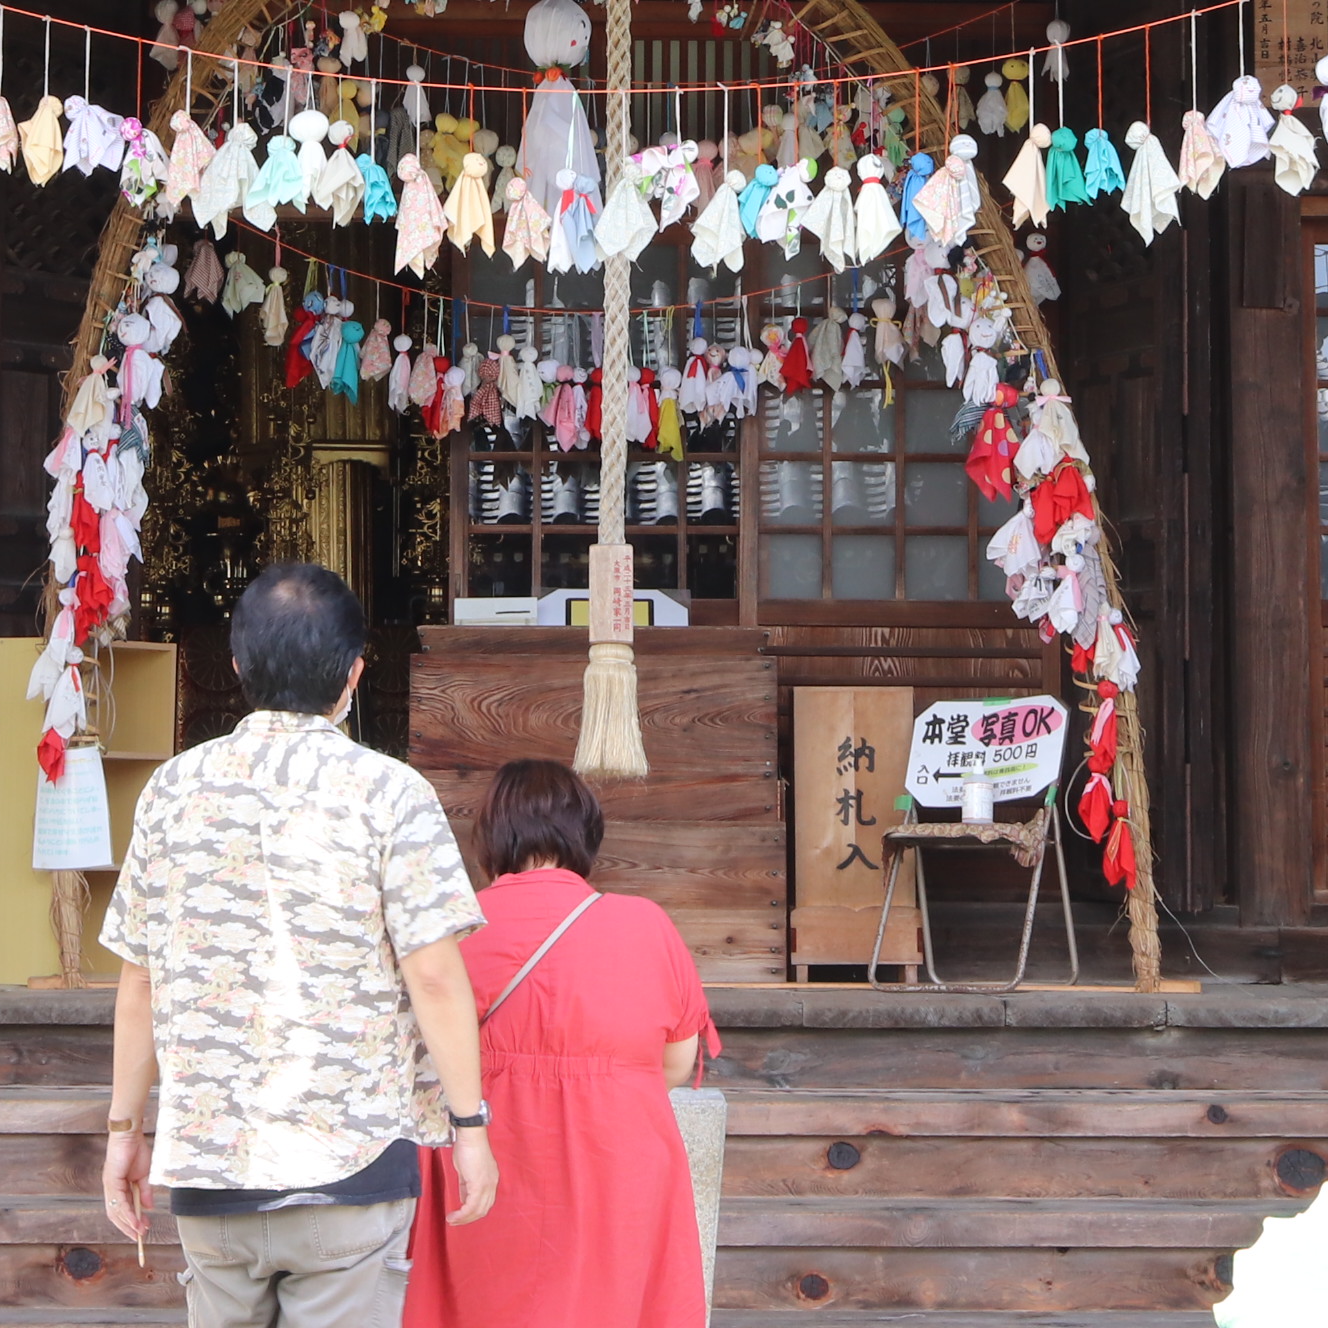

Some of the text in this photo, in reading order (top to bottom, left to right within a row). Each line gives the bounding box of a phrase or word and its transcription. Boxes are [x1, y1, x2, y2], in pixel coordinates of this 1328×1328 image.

[922, 713, 969, 746] 本堂
[916, 763, 930, 785] 入口
[835, 735, 879, 871] 納札入
